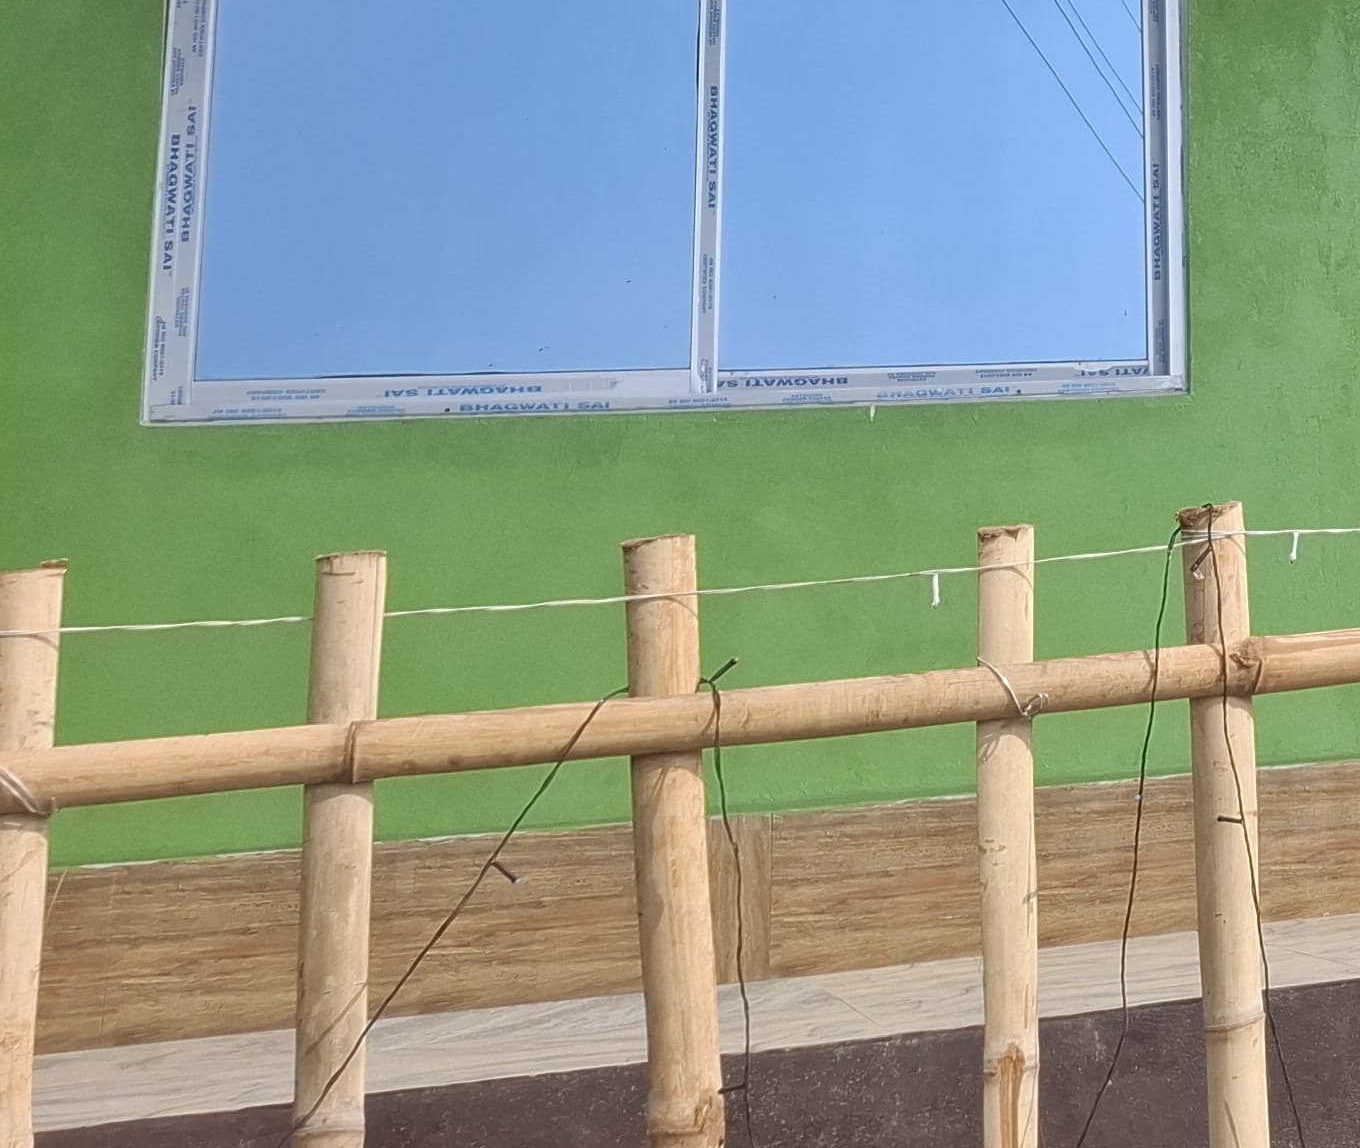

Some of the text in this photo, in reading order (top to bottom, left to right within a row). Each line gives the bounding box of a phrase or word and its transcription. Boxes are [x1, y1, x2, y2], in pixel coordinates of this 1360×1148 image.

[163, 134, 181, 270] BHAGWATI SAI
[182, 105, 197, 242] BHAGWATI SAI
[708, 85, 718, 208] BHAGWATI SAI
[1151, 163, 1161, 279] BHAGWATI SAI
[384, 384, 542, 397] BHAGWATI SAI
[459, 401, 609, 412] BHAGWATI SAI
[717, 375, 848, 388] BHAGWATI SA
